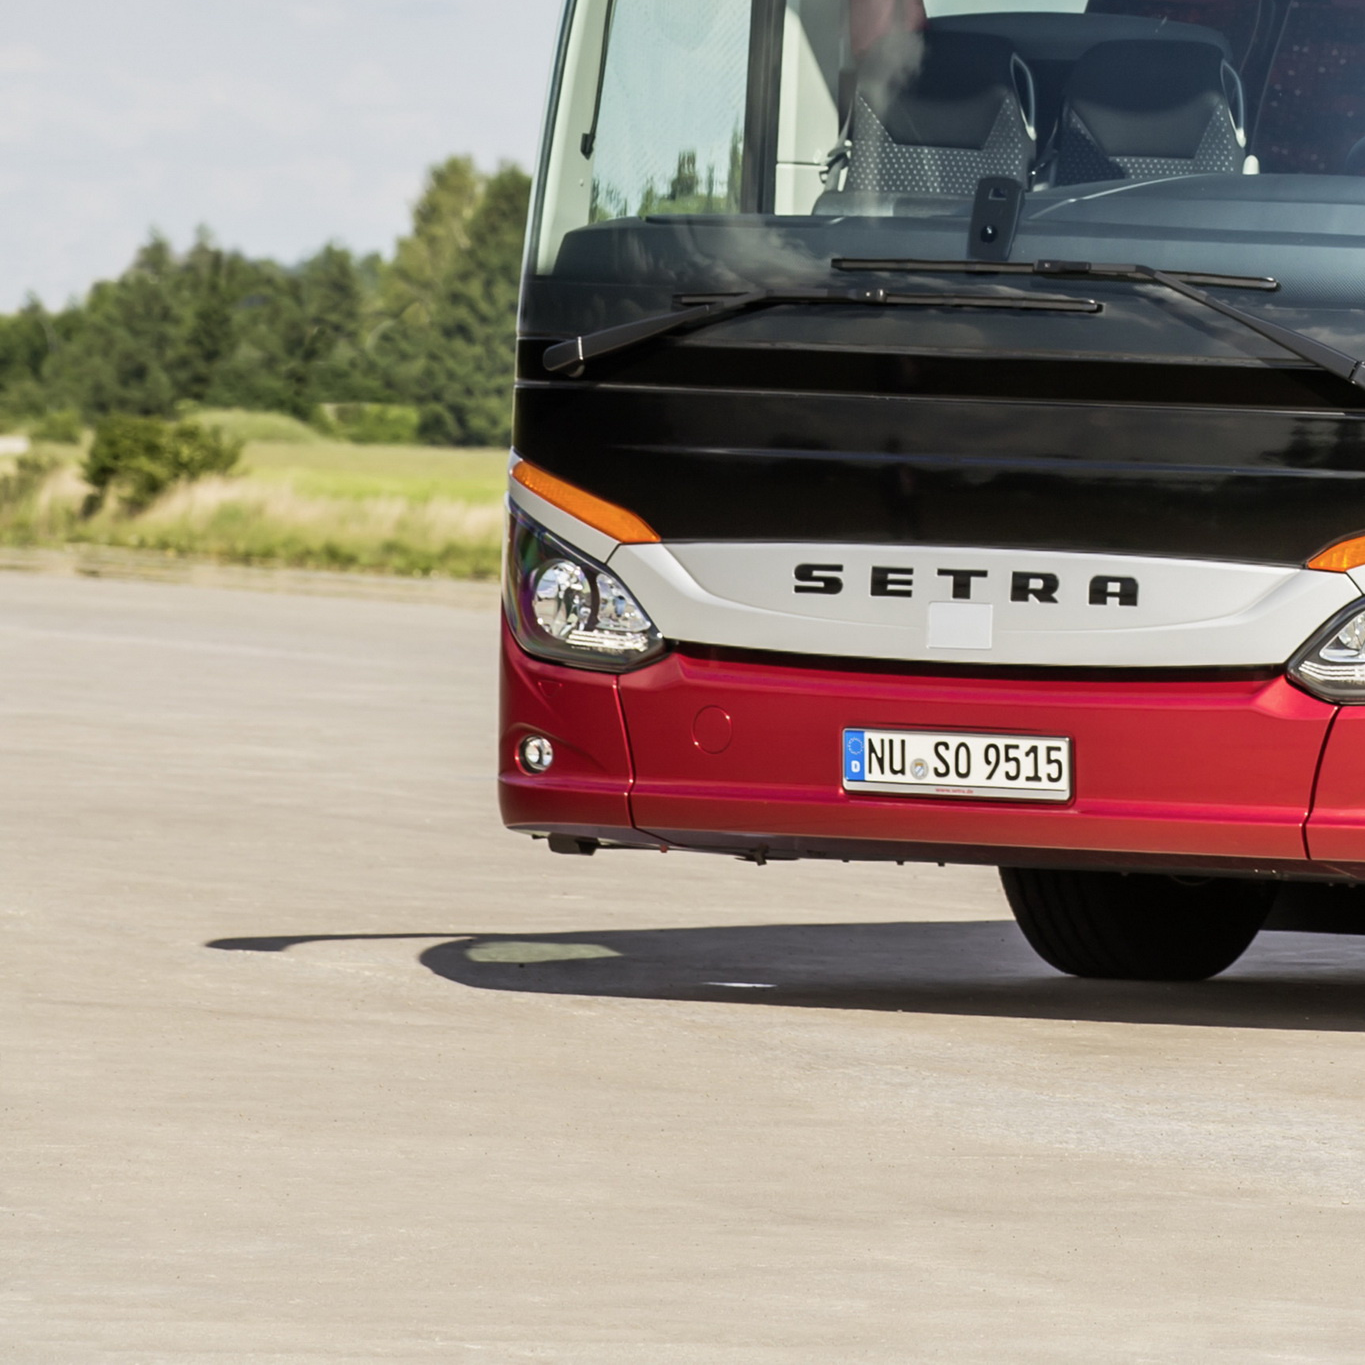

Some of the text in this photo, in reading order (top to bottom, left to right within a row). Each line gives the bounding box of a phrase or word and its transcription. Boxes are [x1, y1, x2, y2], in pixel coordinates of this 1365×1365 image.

[793, 563, 1139, 606] SETRA
[851, 760, 860, 772] D
[868, 738, 1063, 783] NU SO 9515
